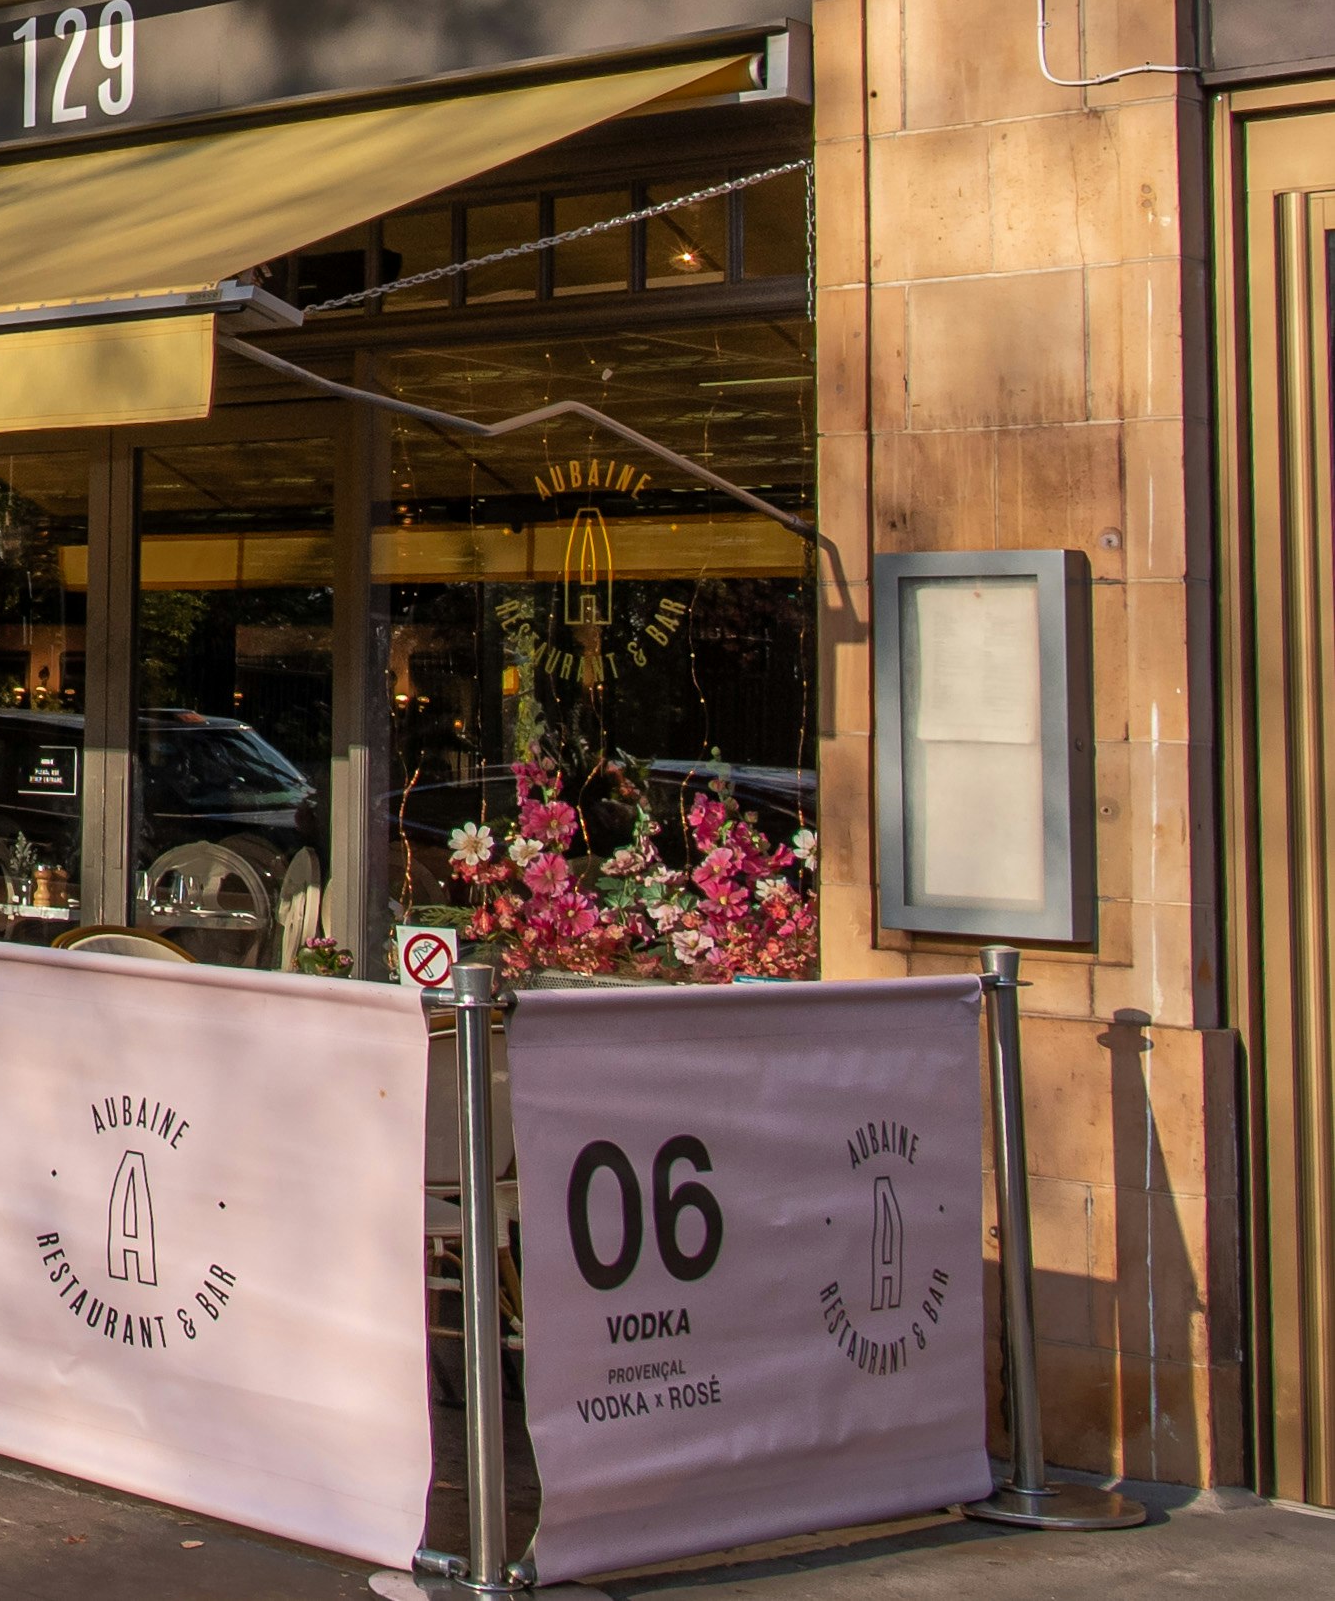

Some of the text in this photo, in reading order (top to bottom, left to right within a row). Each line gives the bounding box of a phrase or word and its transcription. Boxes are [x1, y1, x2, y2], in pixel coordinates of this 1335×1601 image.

[534, 458, 652, 501] AUBAINE
[644, 597, 688, 648] BAR
[90, 1095, 190, 1150] AUBAINE
[847, 1120, 920, 1170] AUBAINE
[566, 1134, 724, 1292] 06
[35, 1232, 237, 1349] RESTAURANT & BAR
[606, 1307, 692, 1345] VODKA
[819, 1268, 950, 1376] RESTAURANT & BAR
[607, 1359, 687, 1386] PROVENÇAL
[576, 1391, 651, 1425] VODKA
[667, 1373, 722, 1411] ROSÉ
